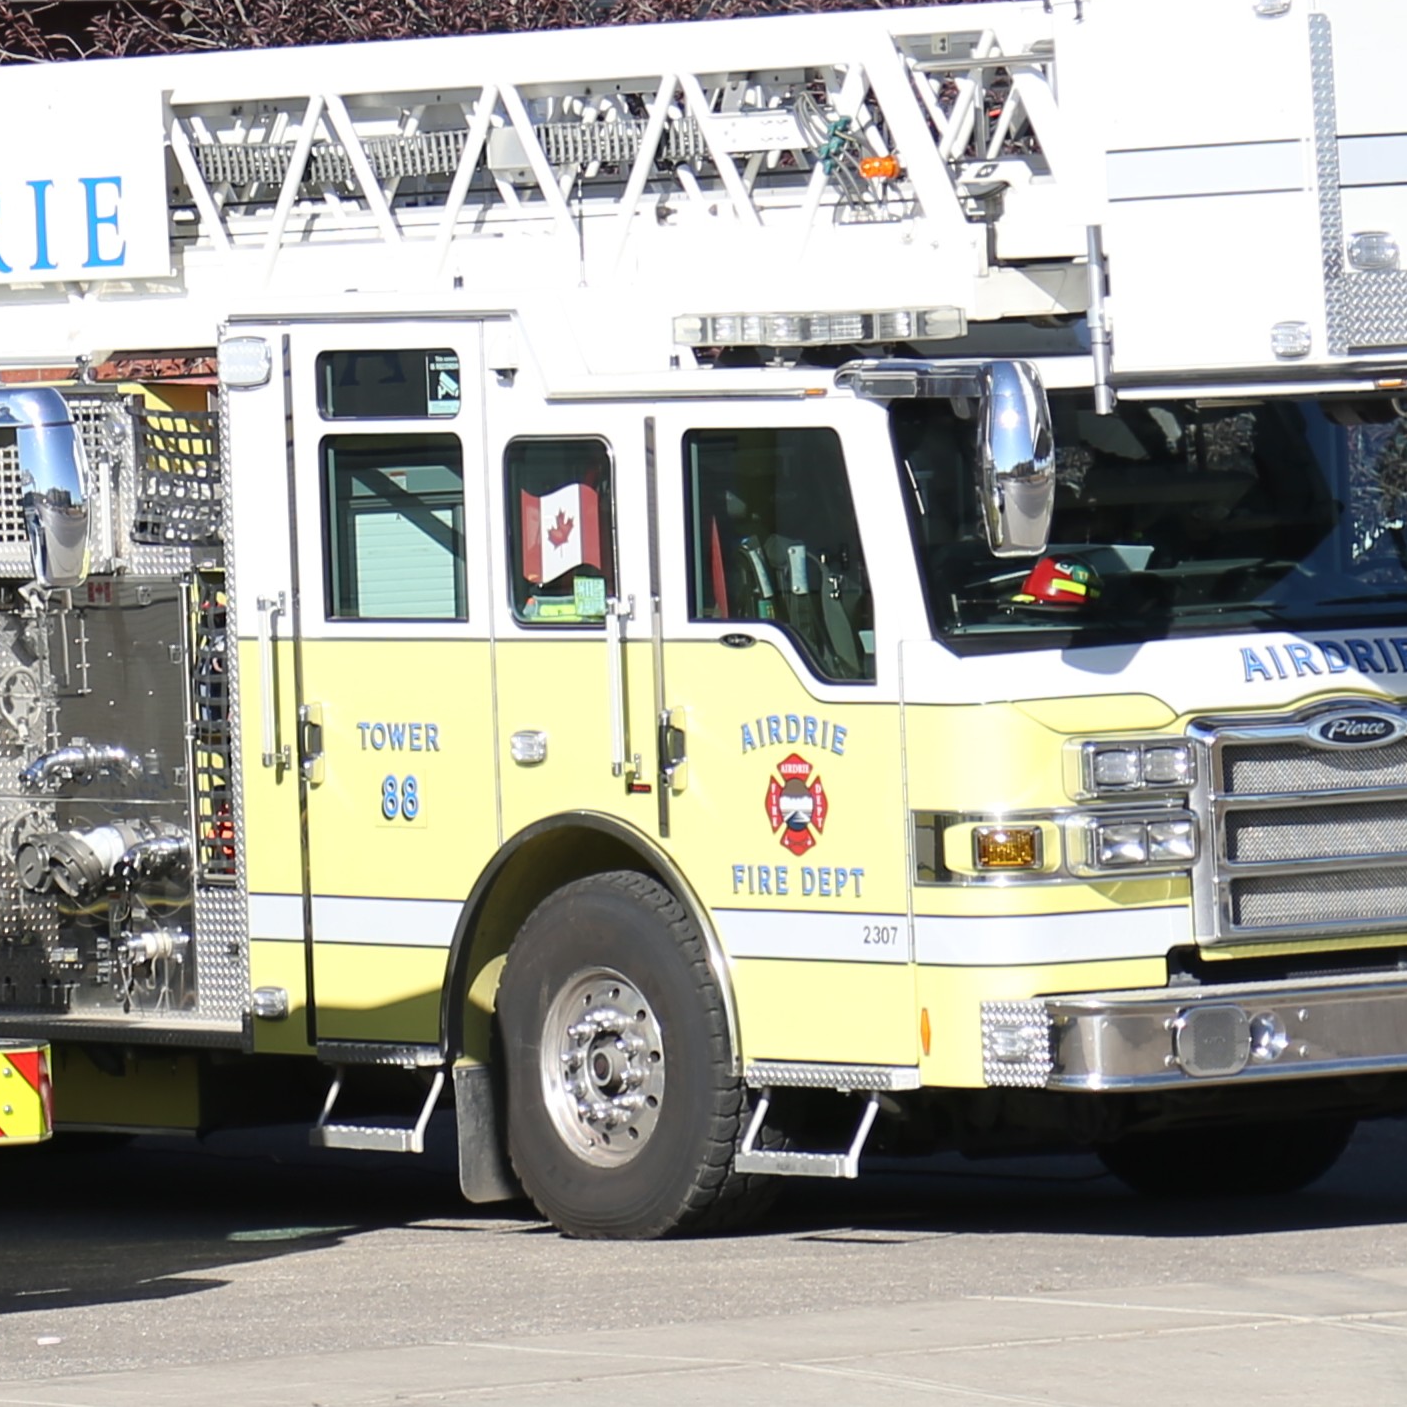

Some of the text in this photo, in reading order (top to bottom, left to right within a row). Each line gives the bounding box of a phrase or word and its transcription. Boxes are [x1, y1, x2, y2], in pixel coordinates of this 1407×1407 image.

[356, 721, 440, 752] TOWER
[741, 714, 848, 756] AIRDRIE
[1327, 718, 1386, 740] Pierce
[780, 763, 810, 774] AIRDRIE
[381, 774, 419, 822] 88
[732, 864, 865, 898] FIRE DEPT
[863, 926, 898, 945] 2307
